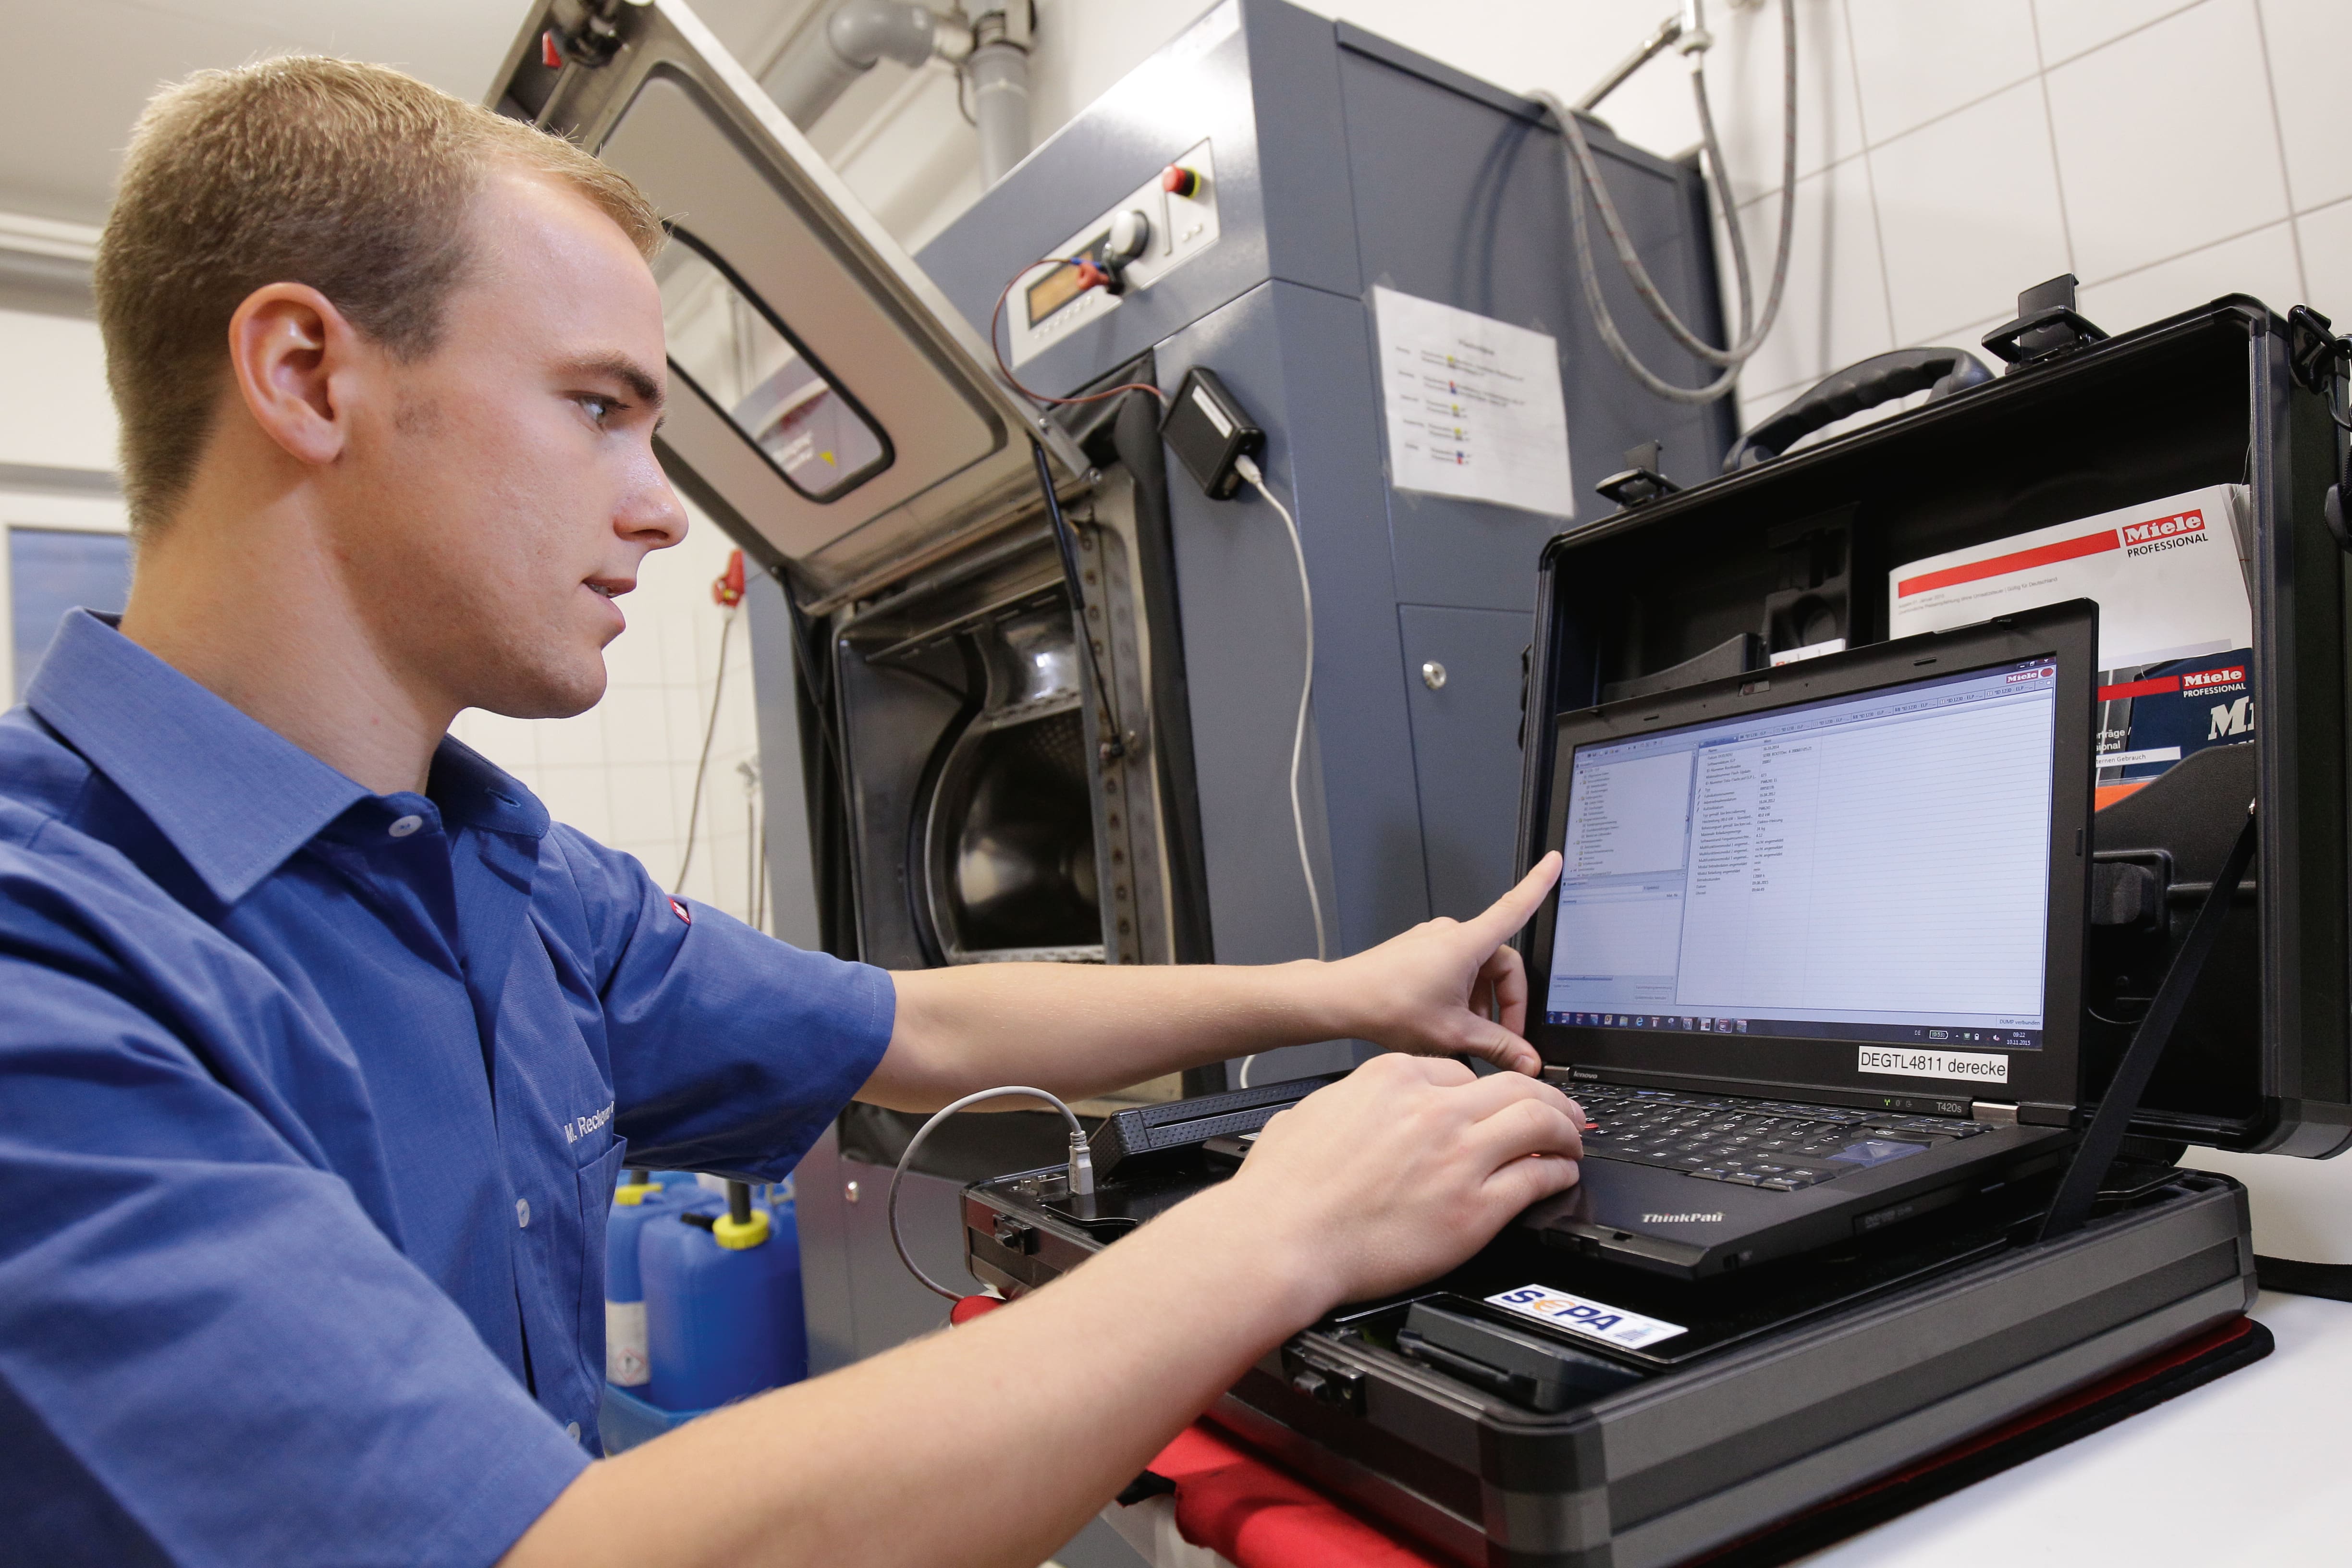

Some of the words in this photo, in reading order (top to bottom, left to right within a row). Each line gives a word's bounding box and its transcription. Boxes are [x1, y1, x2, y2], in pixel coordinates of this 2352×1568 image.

[2125, 516, 2201, 543] Miele
[2127, 533, 2208, 558] PROFESSIONAL
[2029, 576, 2058, 587] Deutschland
[2008, 672, 2037, 683] Miele
[2184, 670, 2242, 686] Miele
[2183, 683, 2246, 698] PROFESSIONAL
[1861, 1052, 1941, 1071] DEGTL4811
[1948, 1058, 2006, 1076] derecke
[1573, 1071, 1598, 1079] lenovo
[1936, 1102, 1962, 1113] T420s
[1642, 1212, 1725, 1223] ThinkPad
